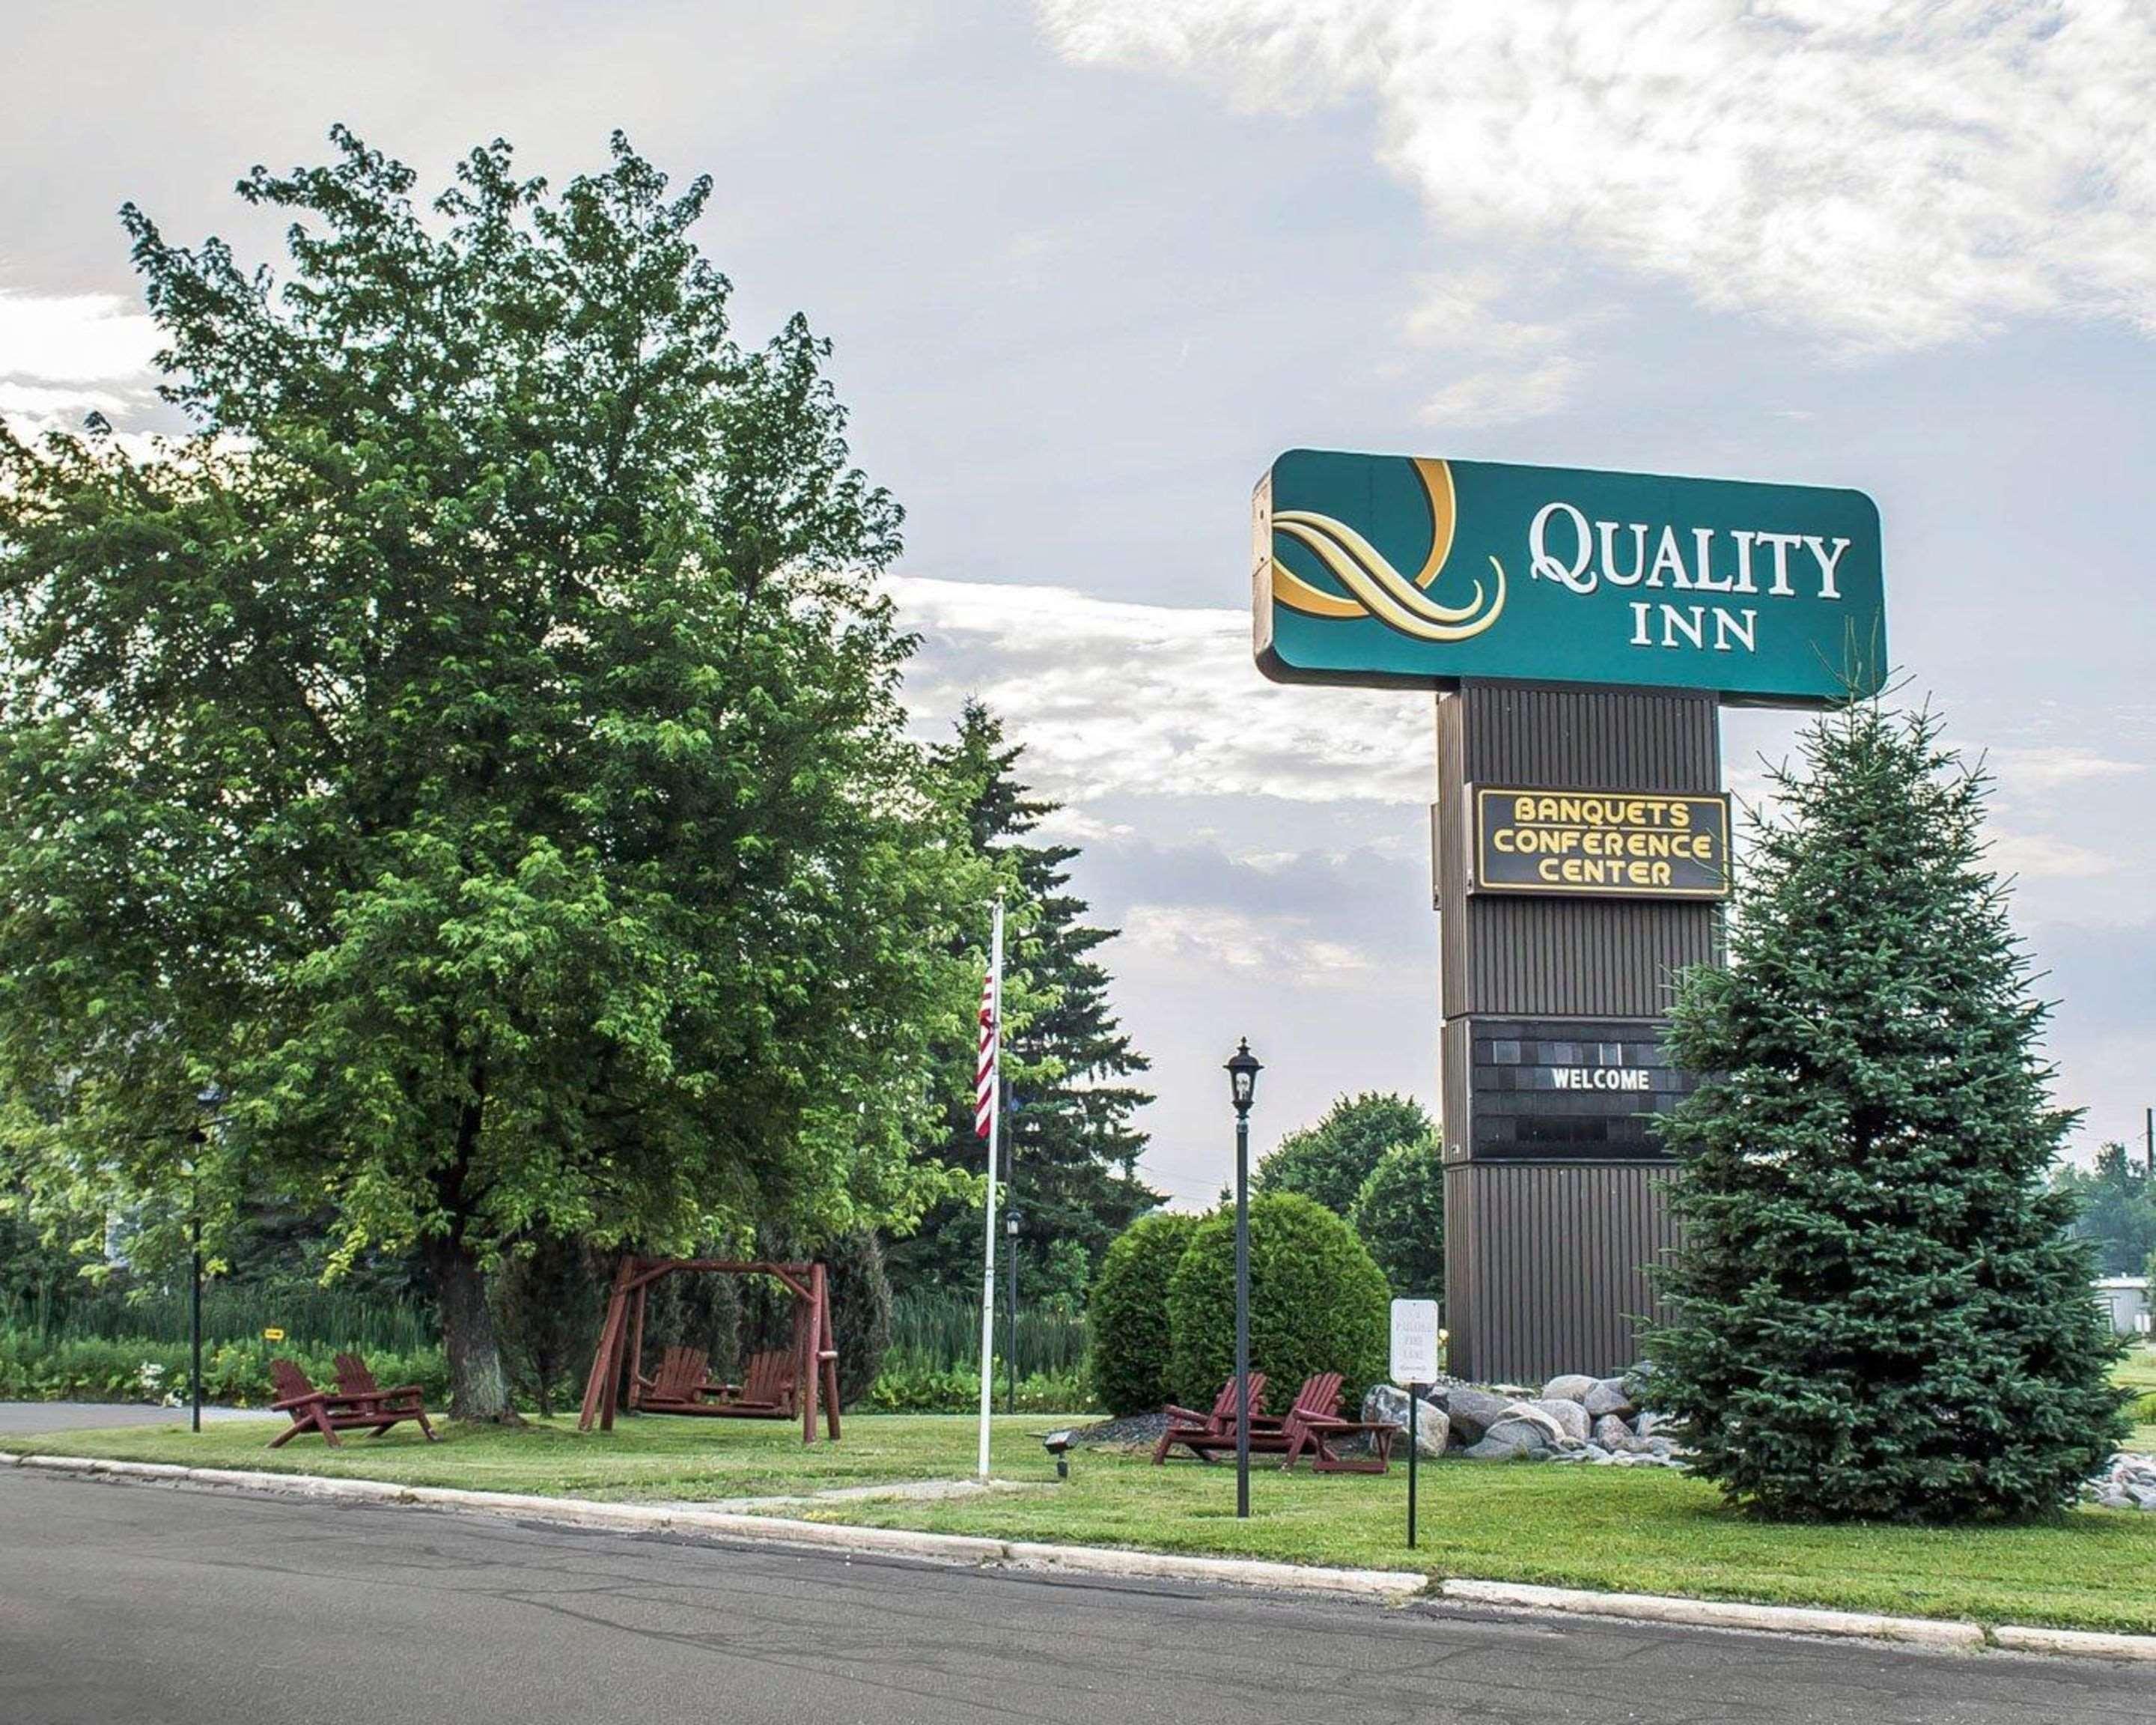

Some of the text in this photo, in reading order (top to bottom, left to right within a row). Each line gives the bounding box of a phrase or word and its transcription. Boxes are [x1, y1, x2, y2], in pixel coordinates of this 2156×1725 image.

[1529, 502, 1851, 599] QUALITY
[1630, 602, 1757, 653] INN
[1514, 797, 1690, 827] BANQUETS
[1493, 829, 1713, 859] CONFERENCE
[1538, 858, 1671, 886] CENTER
[1551, 1068, 1650, 1090] WELCOME
